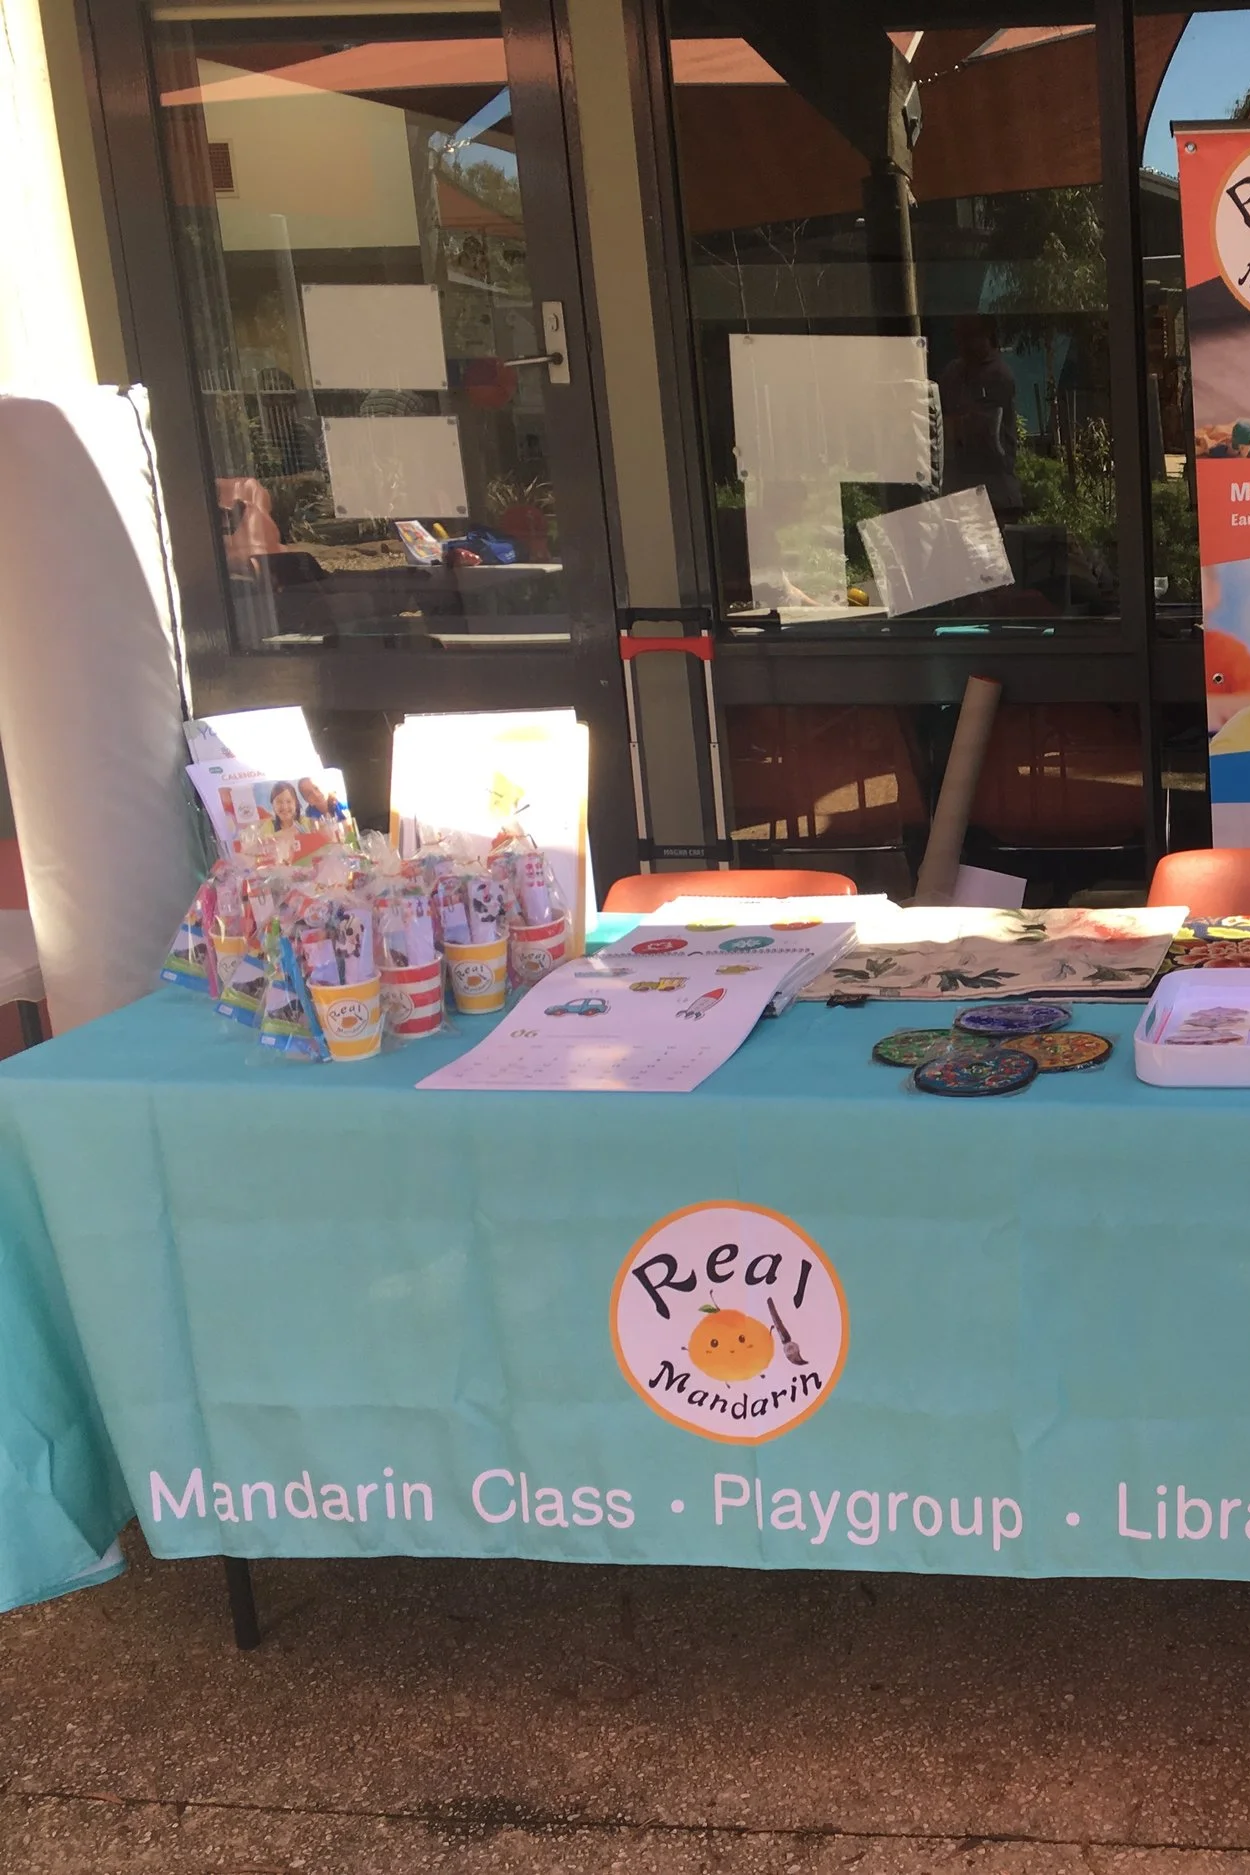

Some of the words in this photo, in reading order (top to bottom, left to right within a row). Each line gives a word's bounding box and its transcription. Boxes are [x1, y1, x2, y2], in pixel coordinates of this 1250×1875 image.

[455, 965, 484, 982] Real
[328, 1004, 361, 1022] Real
[631, 1243, 813, 1320] Real
[648, 1360, 822, 1420] Mandarin
[148, 1466, 434, 1523] Mandarin
[471, 1468, 636, 1529] Class
[713, 1473, 1024, 1552] Playgroup
